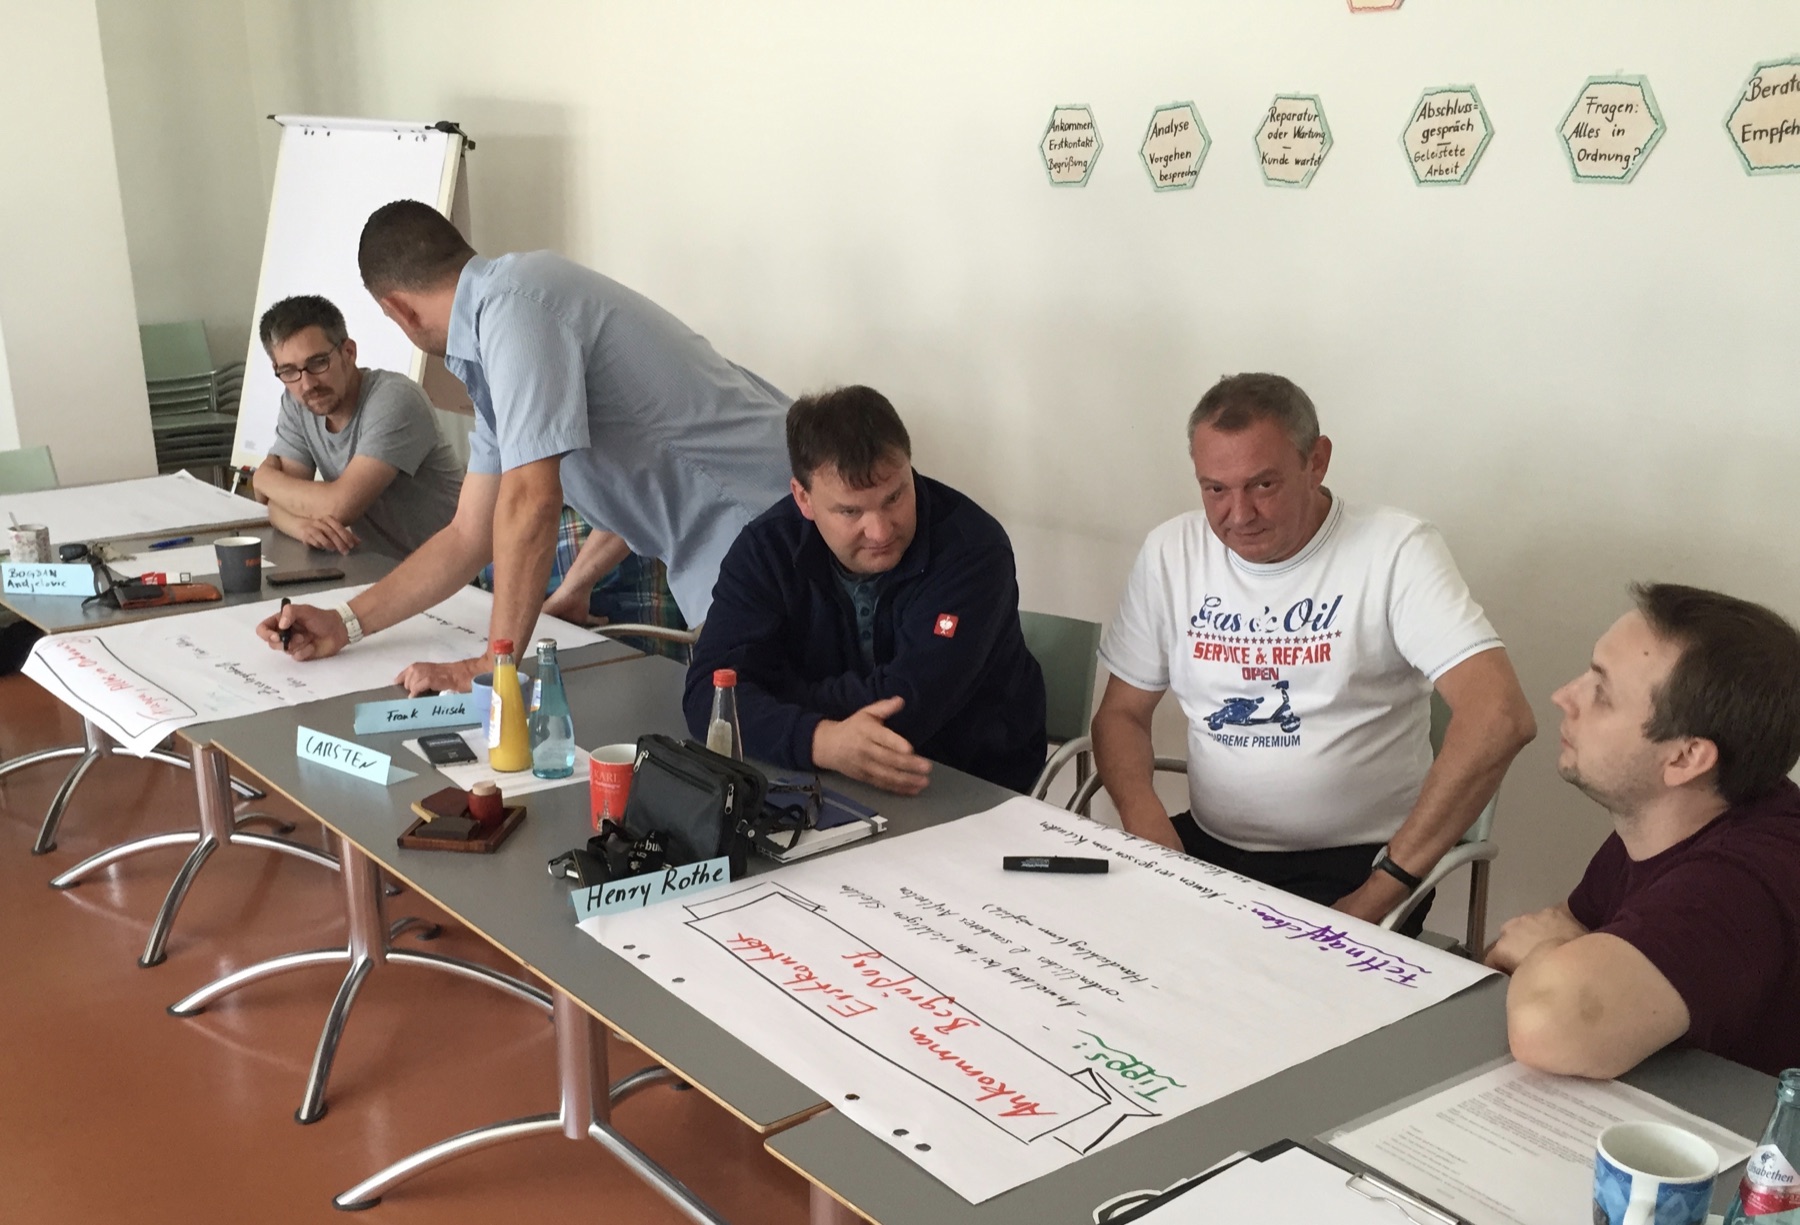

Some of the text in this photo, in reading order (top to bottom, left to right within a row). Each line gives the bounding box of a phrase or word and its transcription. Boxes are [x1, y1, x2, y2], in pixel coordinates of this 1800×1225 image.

[1269, 106, 1319, 126] Reparatur
[1585, 96, 1639, 122] Fragen:
[1049, 119, 1094, 133] Ankommen
[1150, 119, 1190, 141] Analyse
[1267, 125, 1326, 144] oder Wartung
[1421, 120, 1474, 144] gespräch
[1568, 121, 1626, 141] Alles in
[1049, 137, 1094, 151] Erstkontakt
[1414, 145, 1466, 163] Geleistete
[1048, 156, 1088, 174] Begrüßung
[1149, 148, 1192, 168] Vorgehen
[1261, 151, 1322, 167] Kunde wartet
[1424, 162, 1460, 178] Arbeit
[1577, 146, 1641, 170] Ordnung?
[1190, 594, 1242, 632] Gas
[1283, 594, 1344, 633] Oil
[1193, 642, 1332, 666] SERVICE & REPAIR
[1241, 667, 1279, 681] OPEN
[387, 708, 419, 722] Frank
[306, 735, 377, 770] CARSTEN
[1251, 734, 1301, 748] PREMIUM
[1039, 820, 1088, 846] Kunden
[585, 866, 725, 914] Henry Rothe
[1178, 876, 1226, 899] Namen
[899, 886, 957, 917] Auftreten
[892, 910, 954, 942] richtigen
[959, 917, 1012, 944] sauberes
[1067, 939, 1149, 983] Handschlag
[1001, 966, 1080, 1007] Anmeldung
[1036, 955, 1119, 996] ordentliches
[843, 951, 980, 1035] Begrüßung
[727, 933, 1058, 1118] Ankommen Erstkontakt
[1071, 1041, 1168, 1103] Tipps:
